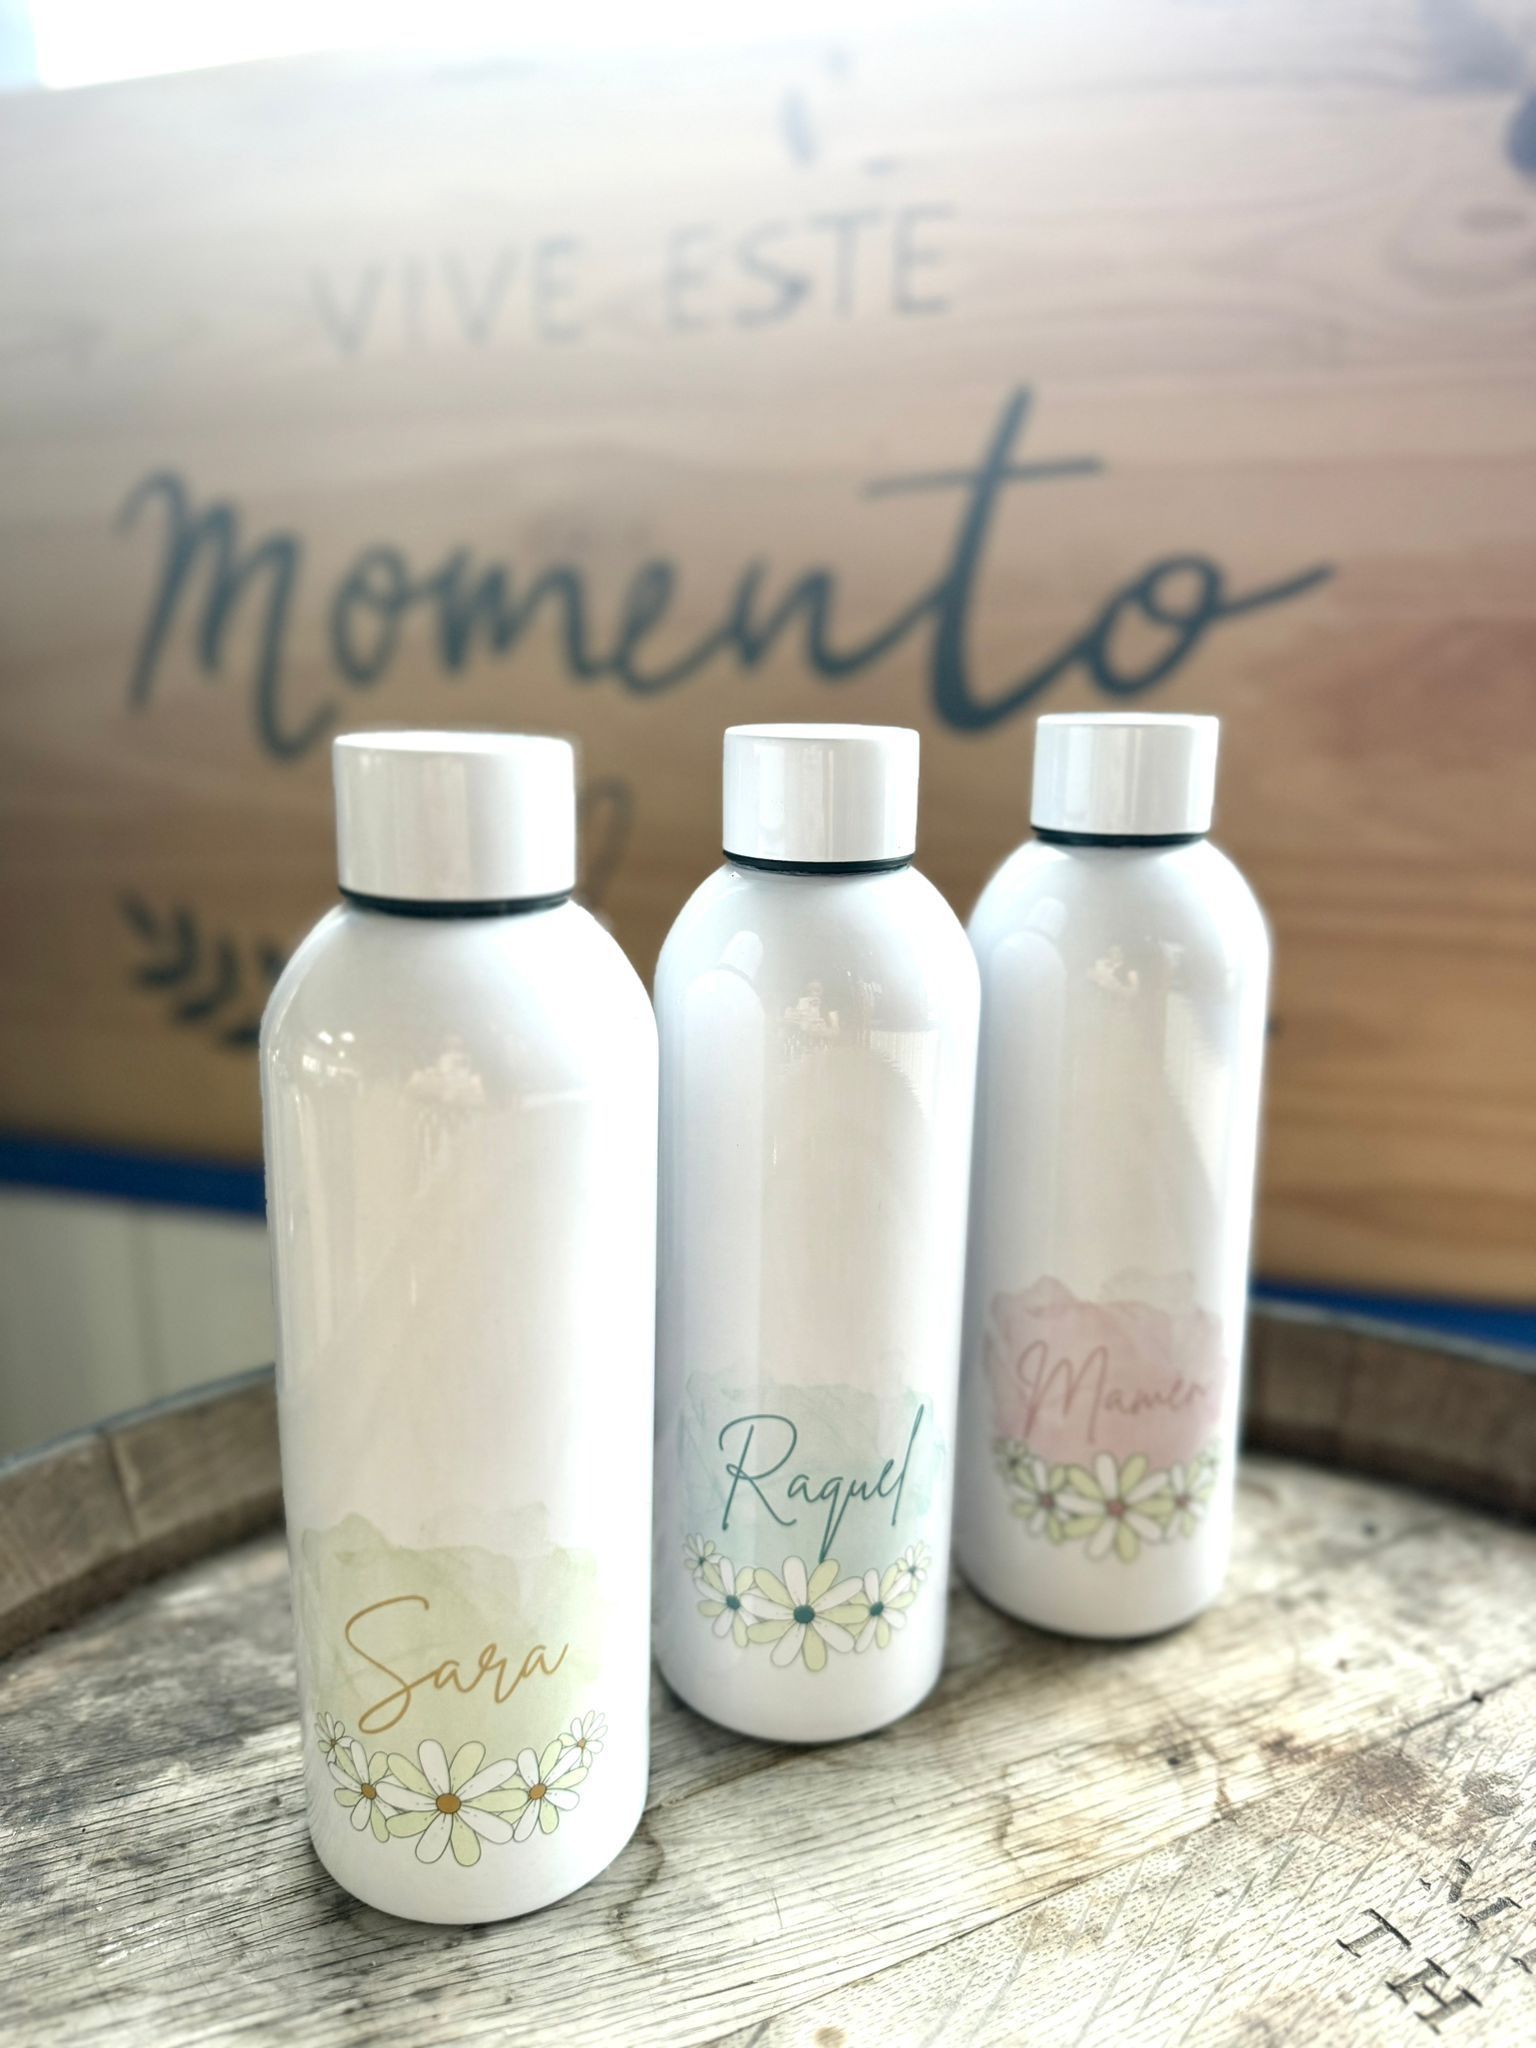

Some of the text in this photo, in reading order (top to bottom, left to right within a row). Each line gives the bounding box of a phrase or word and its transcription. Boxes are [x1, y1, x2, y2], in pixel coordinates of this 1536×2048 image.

[304, 202, 956, 358] VIVE ESTE
[116, 384, 1338, 766] Momento
[718, 1403, 924, 1564] Raquel
[344, 1594, 568, 1734] Sara
